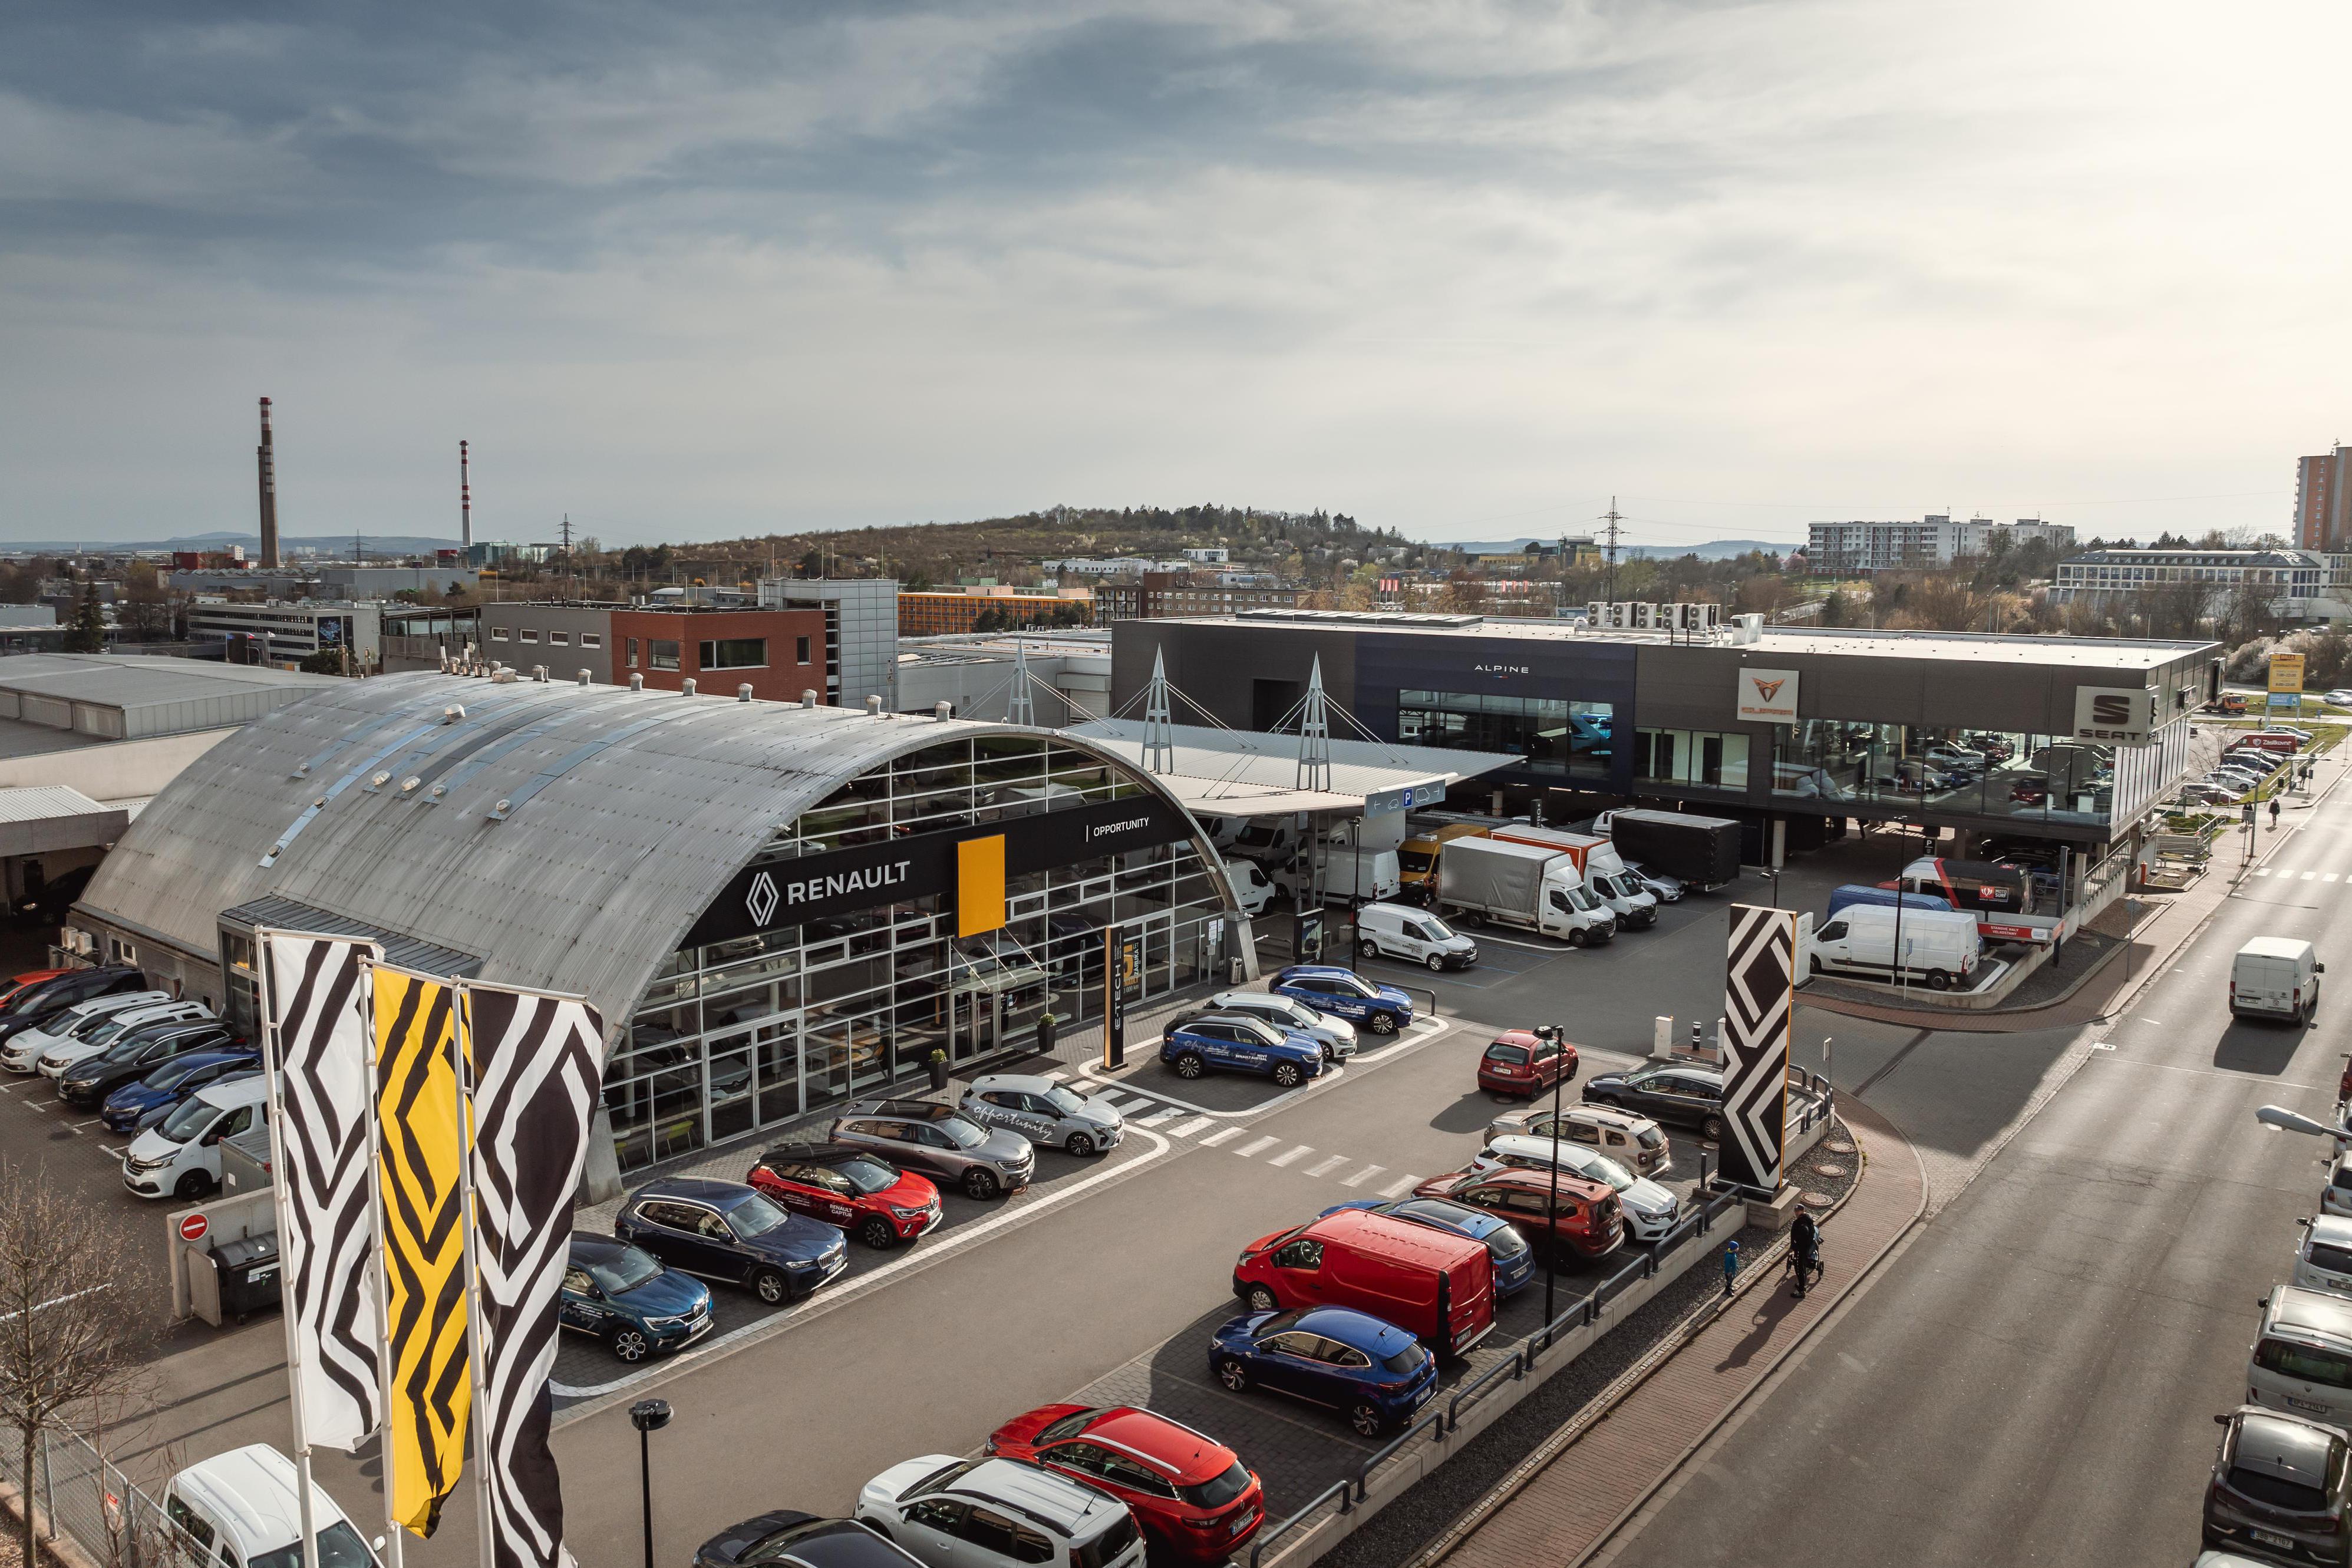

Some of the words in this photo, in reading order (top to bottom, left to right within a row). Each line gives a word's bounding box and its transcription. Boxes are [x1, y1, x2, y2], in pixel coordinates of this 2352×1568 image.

[1475, 665, 1529, 674] ALPINE
[2079, 728, 2141, 741] SEAT
[1405, 792, 1411, 804] P
[1093, 817, 1149, 837] OPPORTUNITY
[787, 860, 911, 905] RENAULT
[973, 1105, 1055, 1140] opportunity
[829, 1204, 853, 1213] RENAULT
[831, 1210, 853, 1218] CAPTUR
